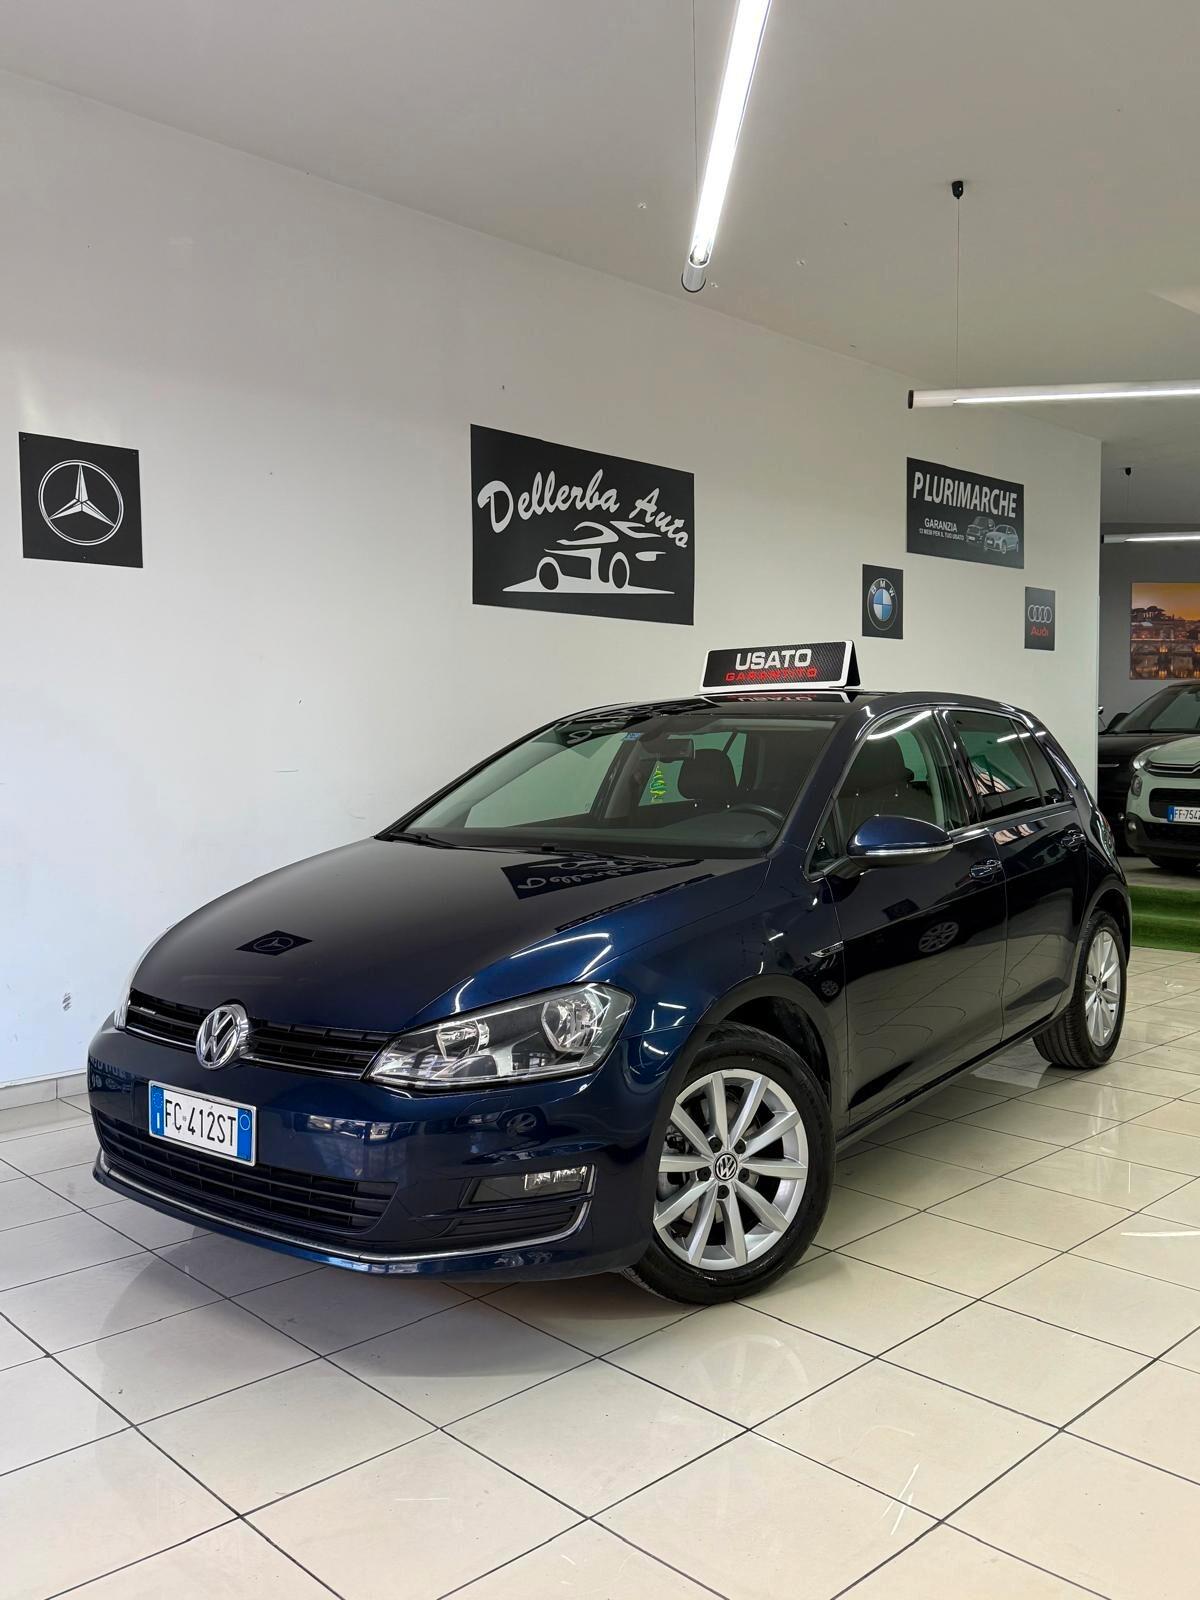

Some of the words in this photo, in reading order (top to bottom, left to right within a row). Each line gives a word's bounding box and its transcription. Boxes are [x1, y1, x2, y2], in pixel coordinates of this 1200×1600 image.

[912, 471, 1018, 518] PLURIMARCHE
[477, 468, 620, 534] Dellerba
[628, 487, 689, 548] Auto
[924, 517, 958, 533] GARANZIA
[870, 580, 896, 597] BMW
[1030, 625, 1049, 637] Audi
[735, 649, 812, 670] USATO
[725, 666, 818, 682] GARANTITO
